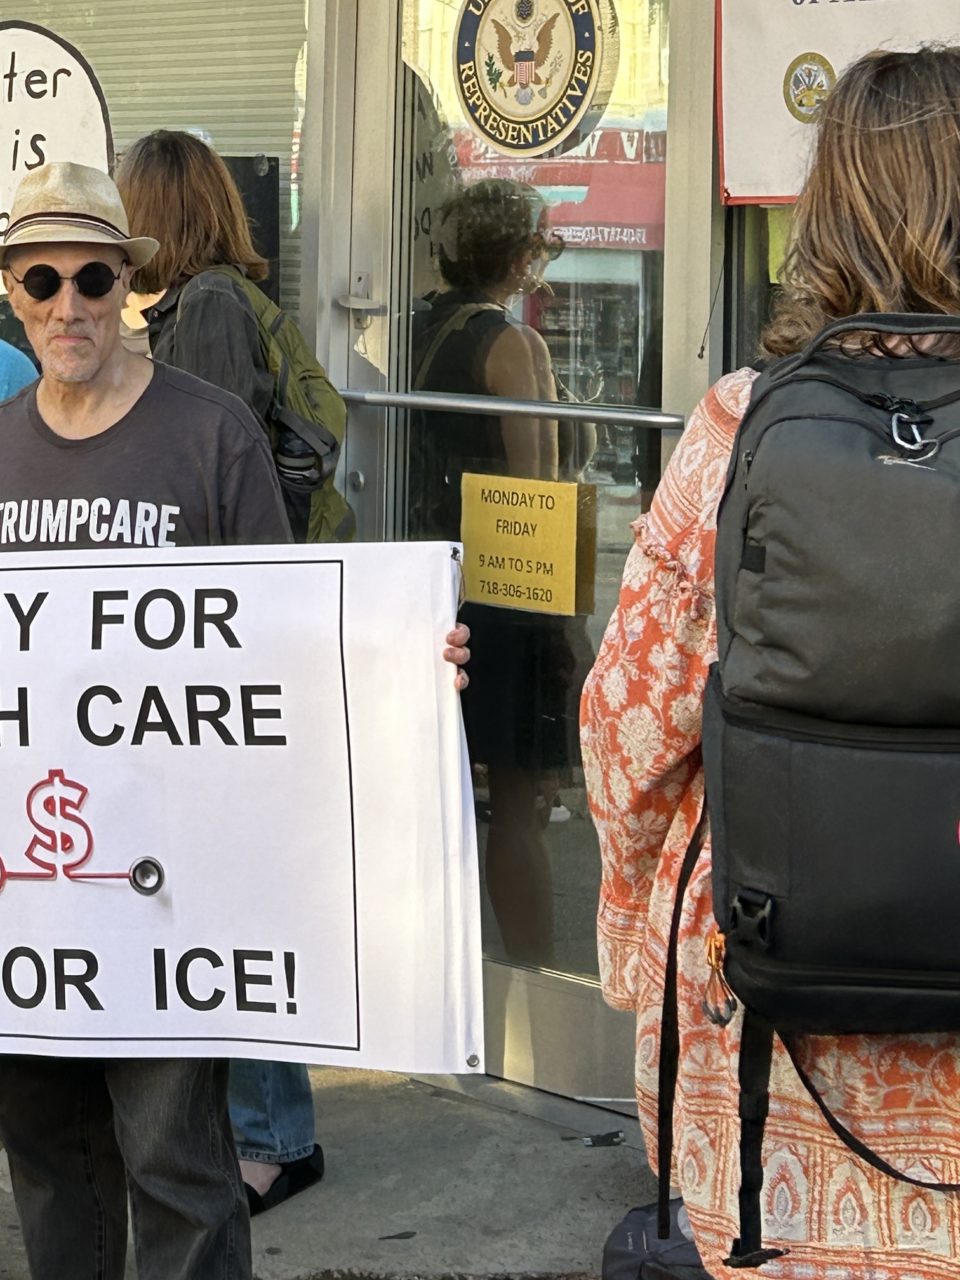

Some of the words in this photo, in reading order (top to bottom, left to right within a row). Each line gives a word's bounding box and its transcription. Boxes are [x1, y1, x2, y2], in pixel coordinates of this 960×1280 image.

[460, 49, 593, 146] REPRESENTATIVES
[12, 129, 46, 171] is
[481, 489, 536, 509] MONDAY
[538, 495, 555, 510] TO
[496, 519, 538, 537] FRIDAY
[479, 554, 485, 568] 9
[487, 556, 506, 570] AM
[508, 558, 524, 572] TO
[526, 560, 533, 574] 5
[536, 562, 553, 577] PM
[479, 580, 553, 603] 718-306-1620
[91, 588, 243, 651] FOR
[77, 684, 288, 748] CARE
[153, 949, 299, 1015] ICE!
